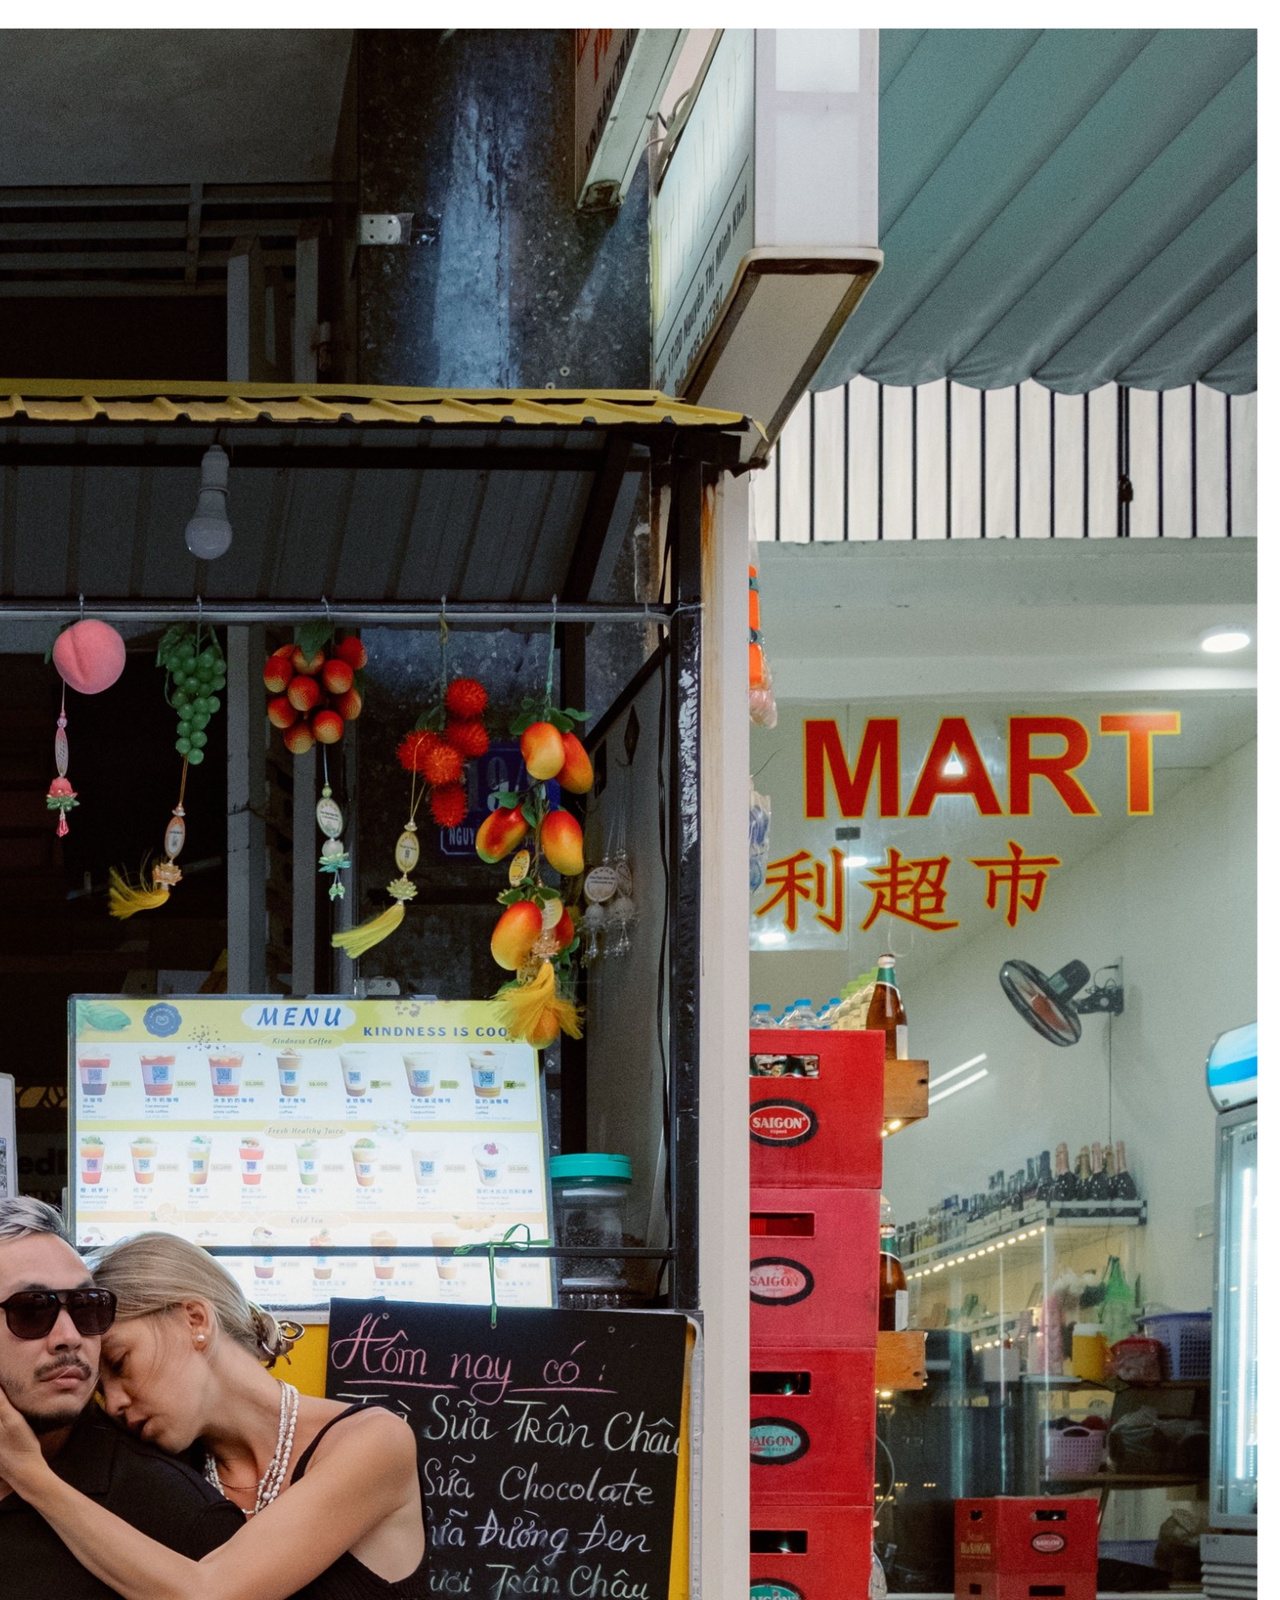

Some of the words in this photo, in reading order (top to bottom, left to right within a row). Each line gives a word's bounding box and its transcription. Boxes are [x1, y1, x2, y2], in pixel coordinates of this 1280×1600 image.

[802, 712, 1181, 820] MART
[753, 840, 1063, 934] 利超市
[257, 1006, 342, 1027] MENU
[272, 1037, 307, 1045] Kindness
[308, 1037, 333, 1046] Coffee
[363, 1026, 447, 1037] KINDNESS
[453, 1026, 469, 1037] IS
[475, 1026, 509, 1038] COO
[268, 1127, 290, 1135] Fresh
[291, 1127, 322, 1137] Healthy
[323, 1127, 345, 1136] Juice
[752, 1116, 803, 1129] SAIGON
[750, 1275, 799, 1288] SAIGON
[331, 1313, 428, 1375] Hôm
[450, 1353, 513, 1405] nay
[542, 1340, 587, 1385] có
[499, 1461, 655, 1506] Chocolate
[426, 1505, 469, 1547] ữa
[474, 1508, 569, 1566] Đường
[578, 1513, 652, 1554] Đen
[429, 1568, 472, 1593] ươi
[570, 1563, 651, 1600] Châu
